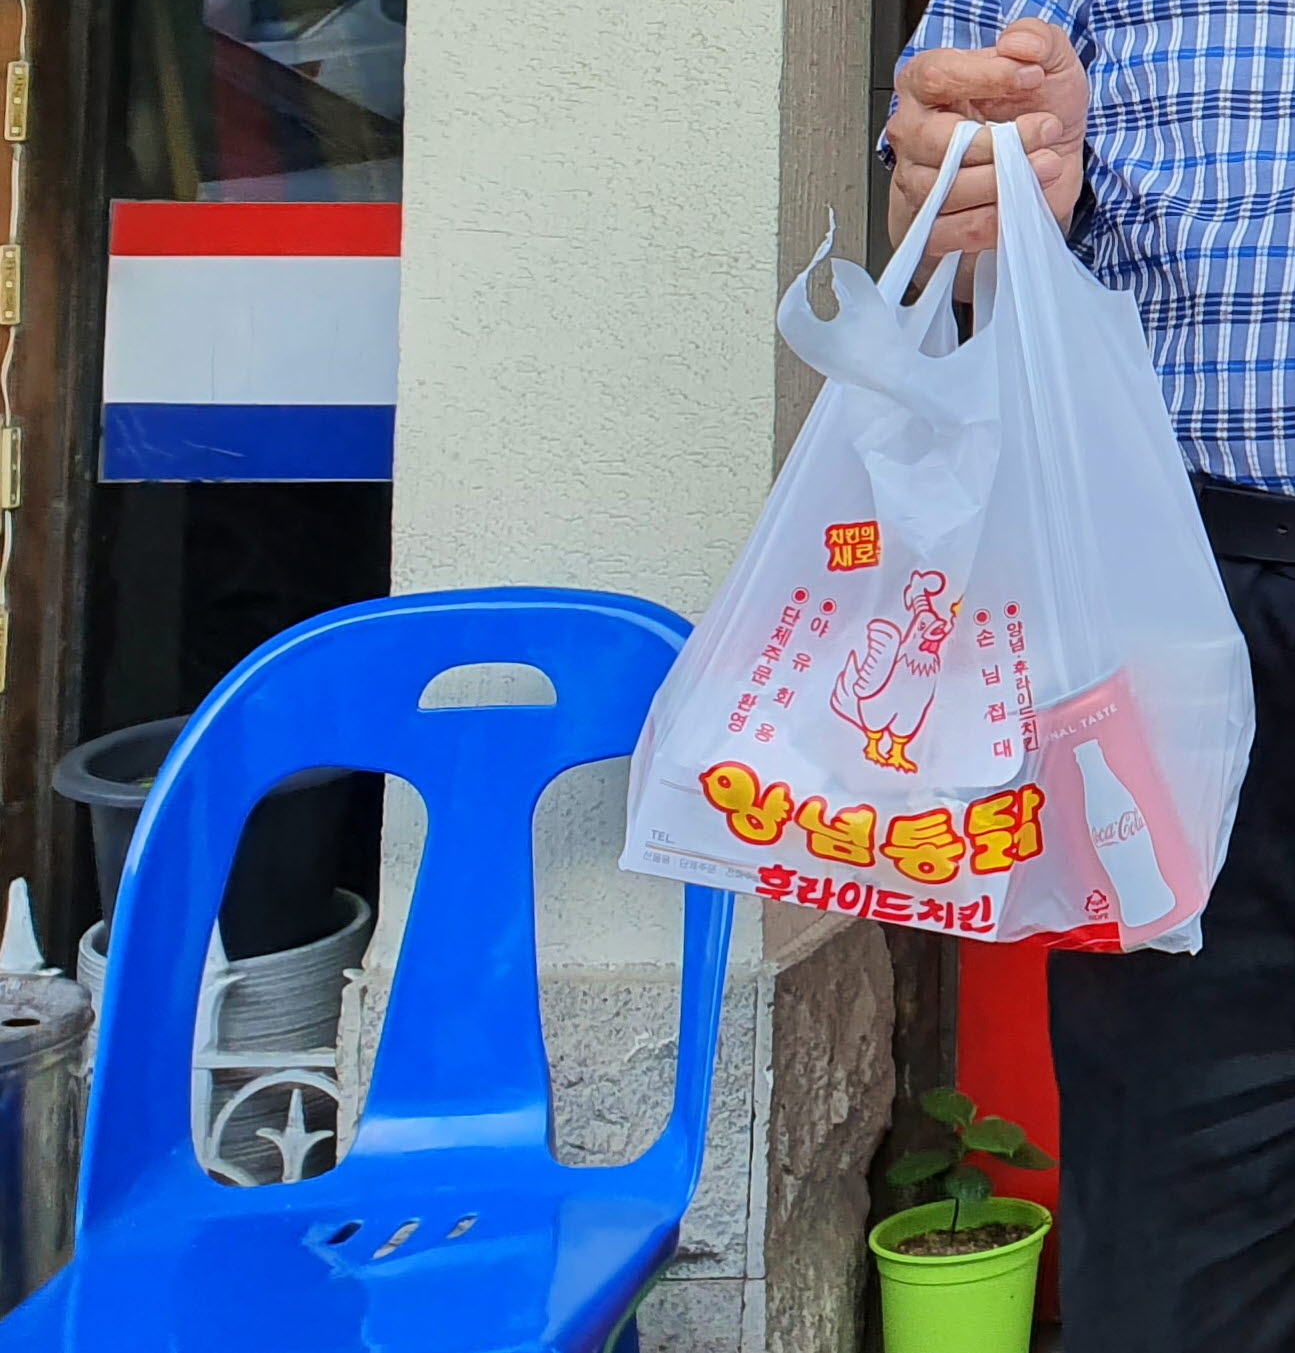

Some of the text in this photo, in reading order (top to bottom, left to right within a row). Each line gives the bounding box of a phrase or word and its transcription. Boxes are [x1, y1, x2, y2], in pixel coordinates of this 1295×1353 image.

[829, 525, 875, 544] 치킨의
[831, 543, 881, 568] 새로
[1079, 703, 1119, 728] TASTE
[699, 760, 1046, 885] 양념통닭
[755, 864, 996, 934] 후라이드치킨
